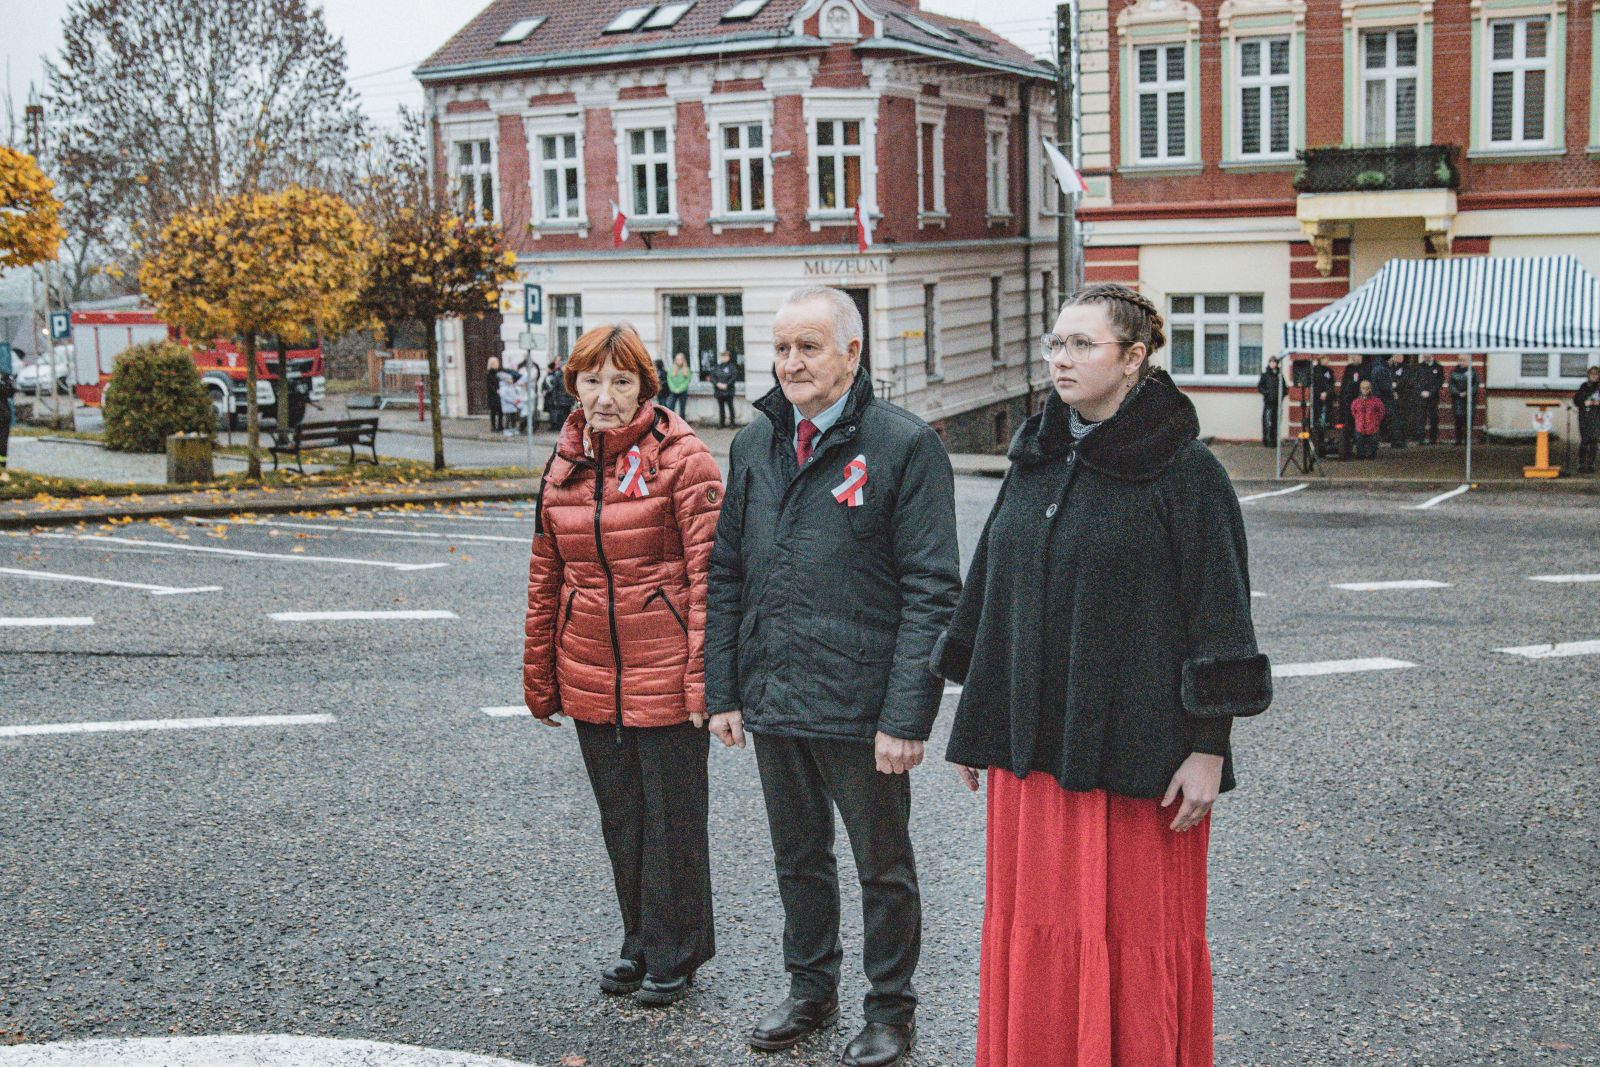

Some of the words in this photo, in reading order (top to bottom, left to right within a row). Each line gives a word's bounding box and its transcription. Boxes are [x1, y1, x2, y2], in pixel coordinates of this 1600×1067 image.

[804, 258, 883, 275] MUZEUM
[528, 286, 539, 320] P
[53, 315, 67, 337] P
